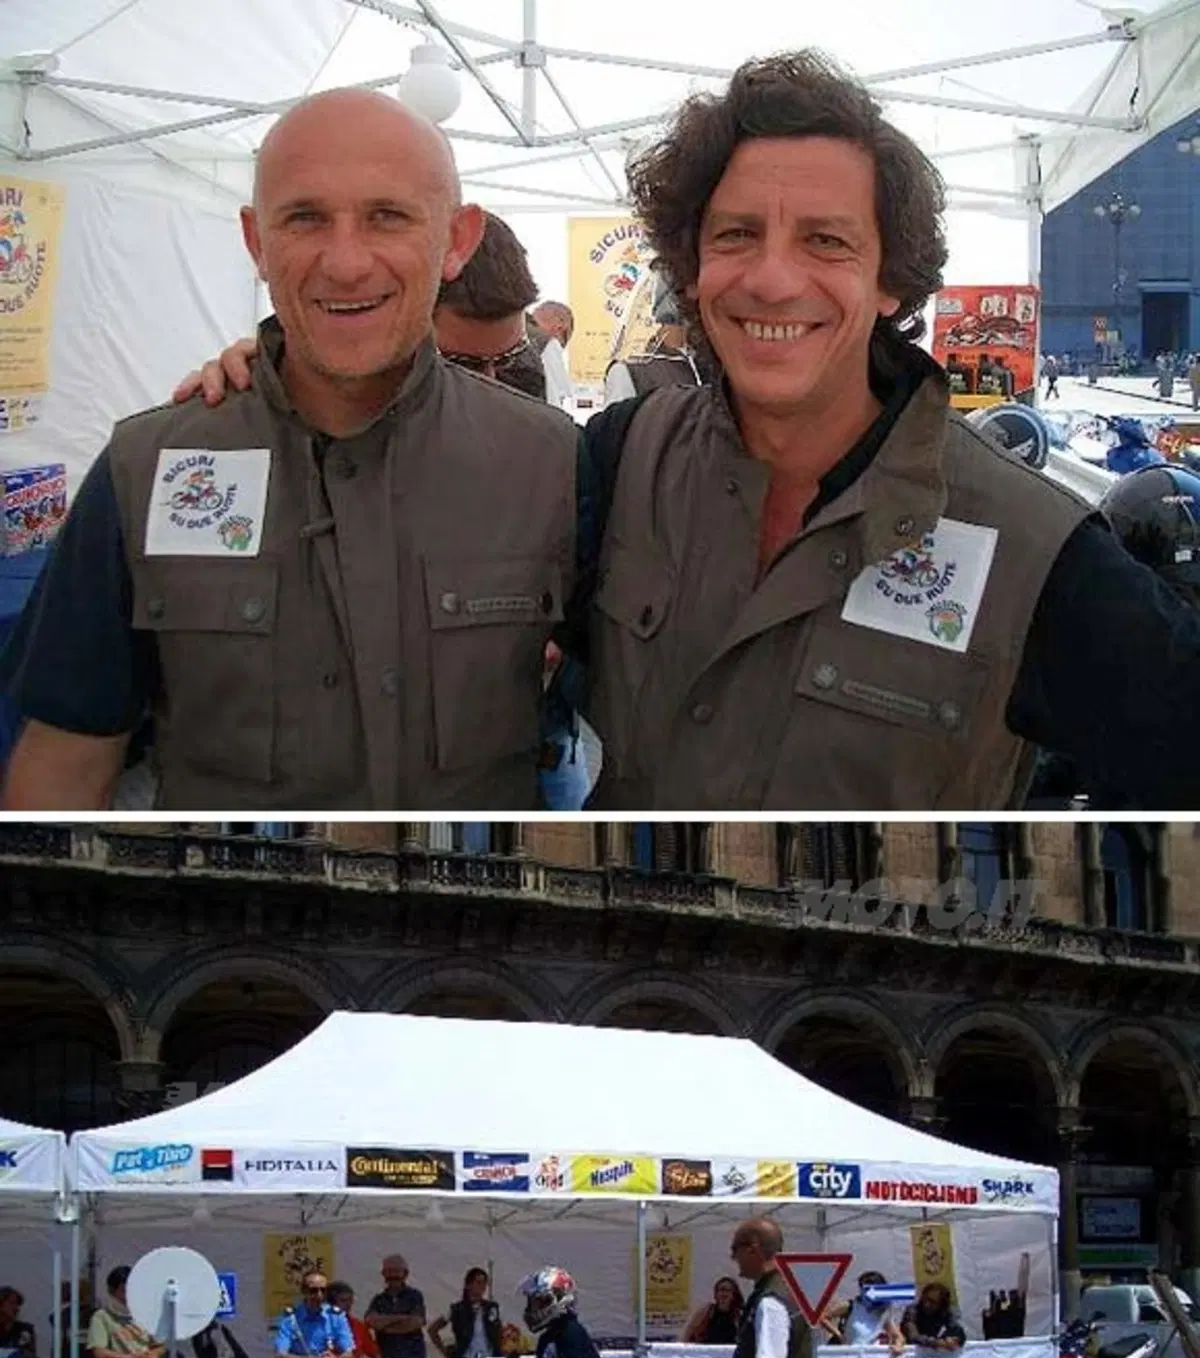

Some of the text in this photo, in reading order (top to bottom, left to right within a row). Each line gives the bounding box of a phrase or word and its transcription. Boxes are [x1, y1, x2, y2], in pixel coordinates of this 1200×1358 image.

[350, 1155, 440, 1176] Continental
[809, 1165, 853, 1197] city
[981, 1178, 1034, 1195] SHARK
